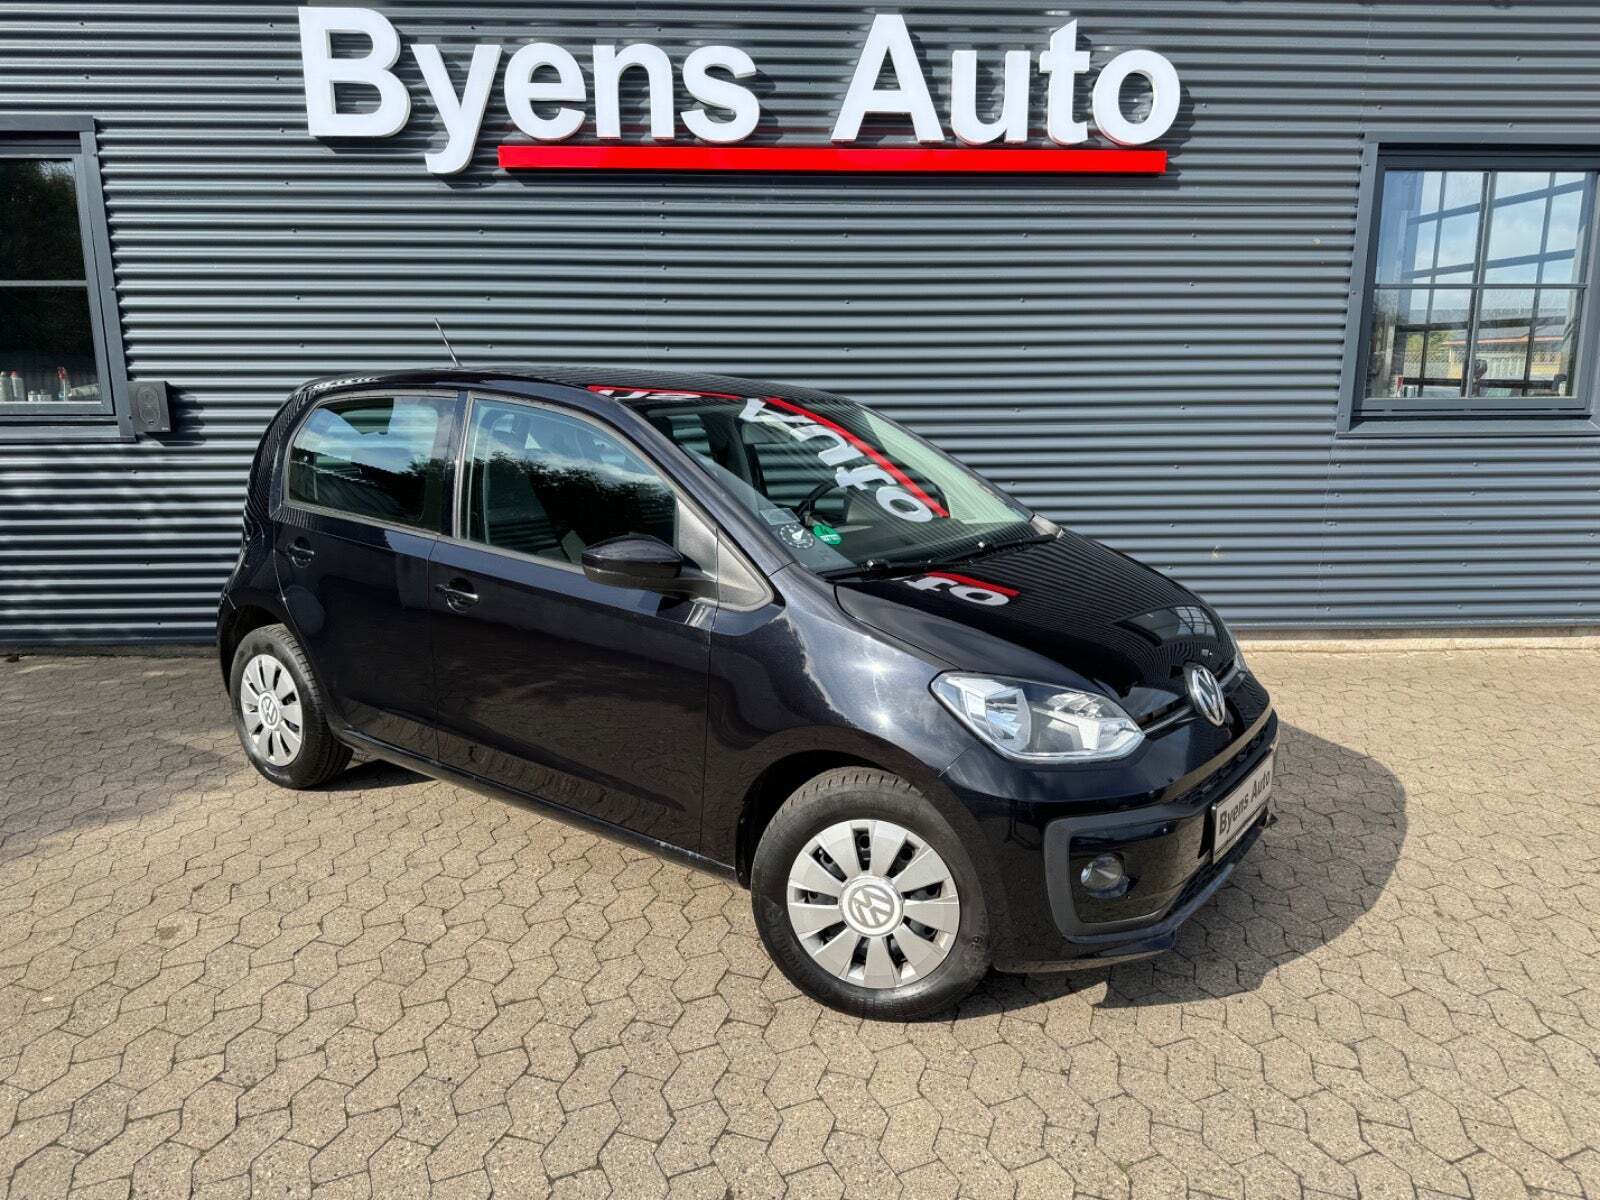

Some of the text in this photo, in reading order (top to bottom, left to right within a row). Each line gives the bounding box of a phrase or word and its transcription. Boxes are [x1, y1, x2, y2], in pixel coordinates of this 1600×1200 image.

[299, 6, 1182, 175] Byens Auto
[1218, 793, 1249, 835] Byens
[1251, 770, 1271, 802] Auto
